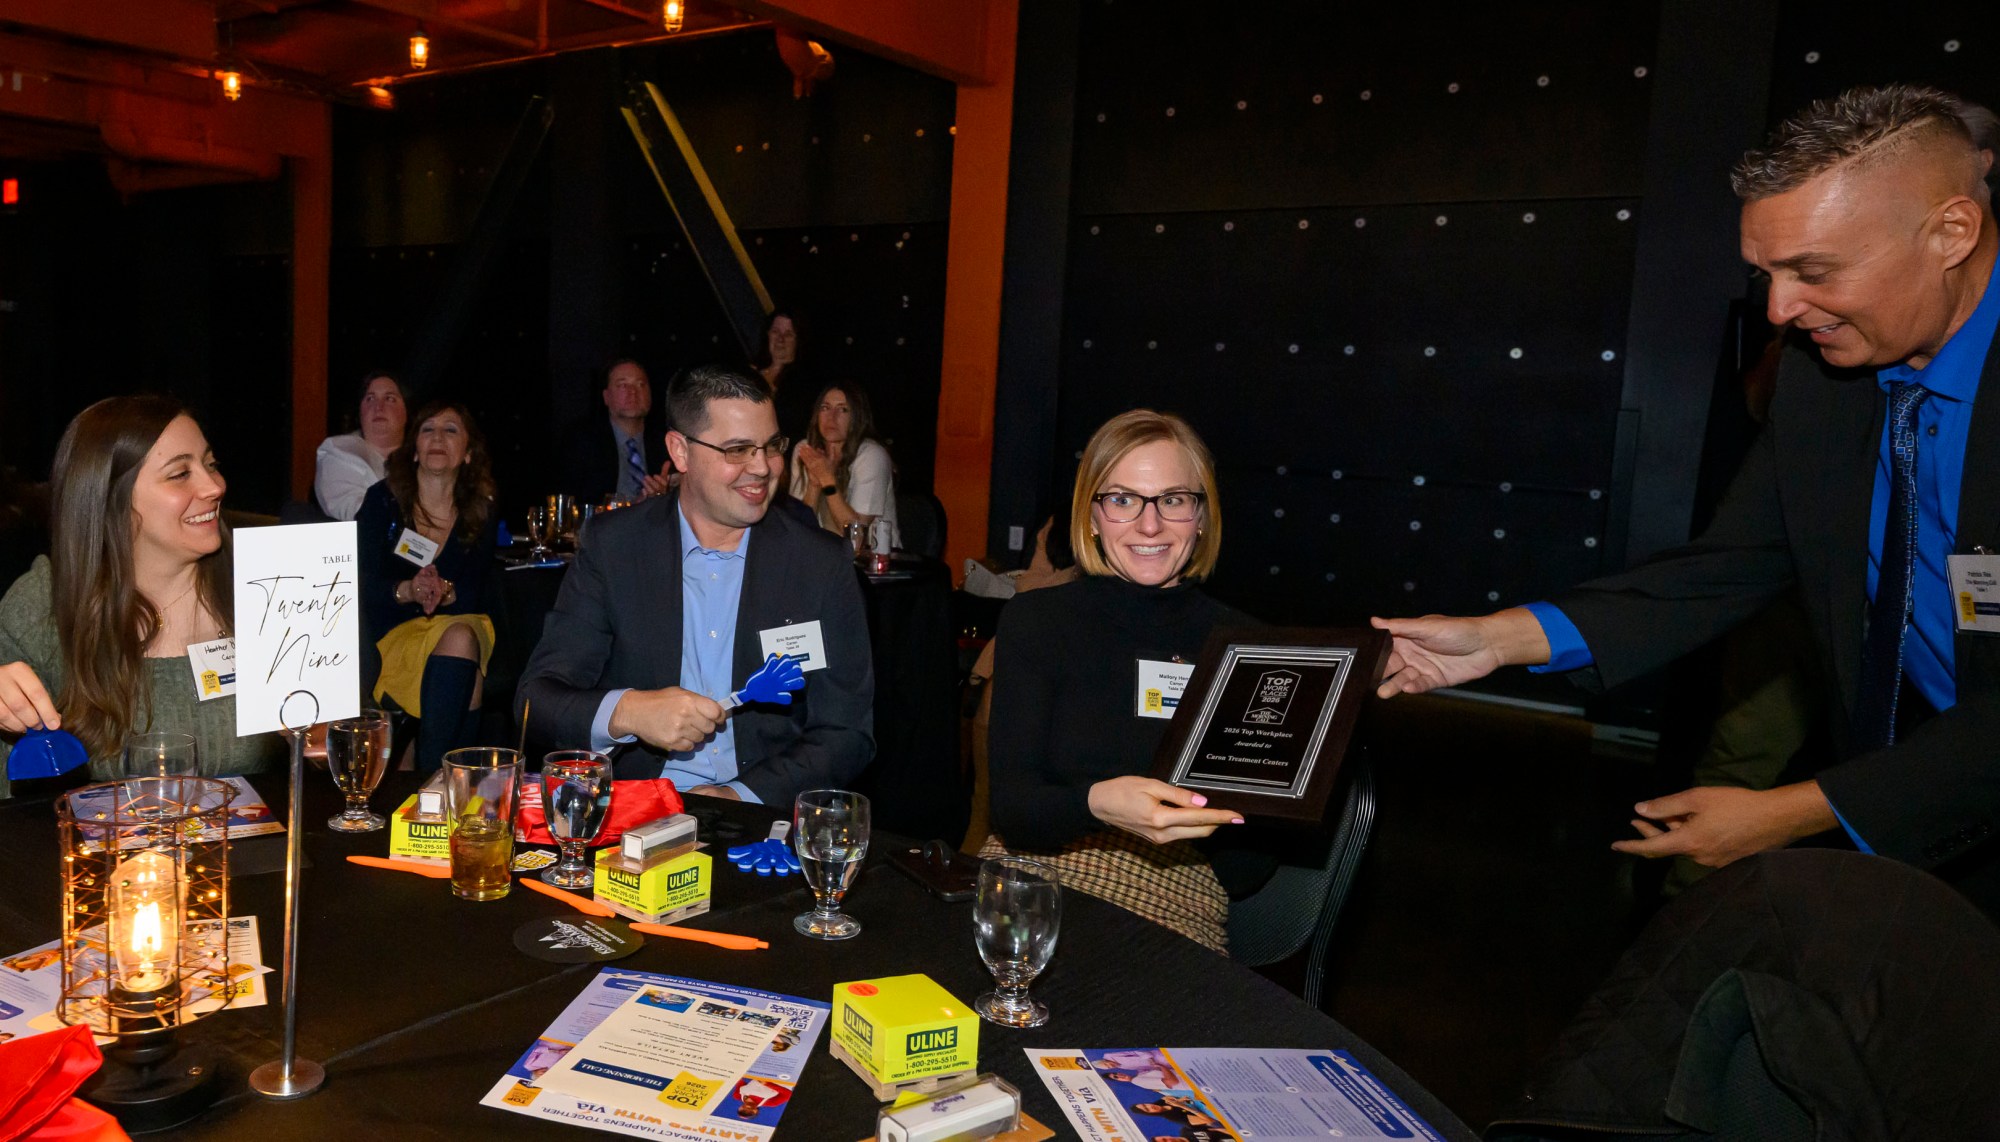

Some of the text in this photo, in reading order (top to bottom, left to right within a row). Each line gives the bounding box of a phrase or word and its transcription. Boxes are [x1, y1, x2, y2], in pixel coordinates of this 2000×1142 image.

[322, 554, 352, 564] TABLE
[246, 571, 352, 637] Twenty
[204, 644, 228, 654] Heather
[266, 626, 348, 684] Nine
[1266, 677, 1293, 686] TOP
[1256, 730, 1293, 738] Workplace
[1228, 756, 1261, 764] Treatment
[411, 824, 448, 838] ULINE
[610, 868, 639, 887] ULINE
[670, 869, 698, 888] ULINE
[846, 1008, 871, 1042] ULINE
[910, 1030, 955, 1051] ULINE
[637, 1043, 709, 1061] EVENT DETAILS
[906, 1055, 957, 1069] 1-800-295-5510
[1046, 1058, 1056, 1067] TOP
[581, 1062, 662, 1086] THE MORNING CALL
[672, 1089, 703, 1100] WORK
[677, 1086, 708, 1097] PLACES
[666, 1095, 697, 1106] TOP
[614, 1109, 662, 1125] WITH
[1072, 1104, 1096, 1132] HAPPENS
[1090, 1108, 1118, 1133] WITH
[603, 1118, 655, 1132] HAPPENS
